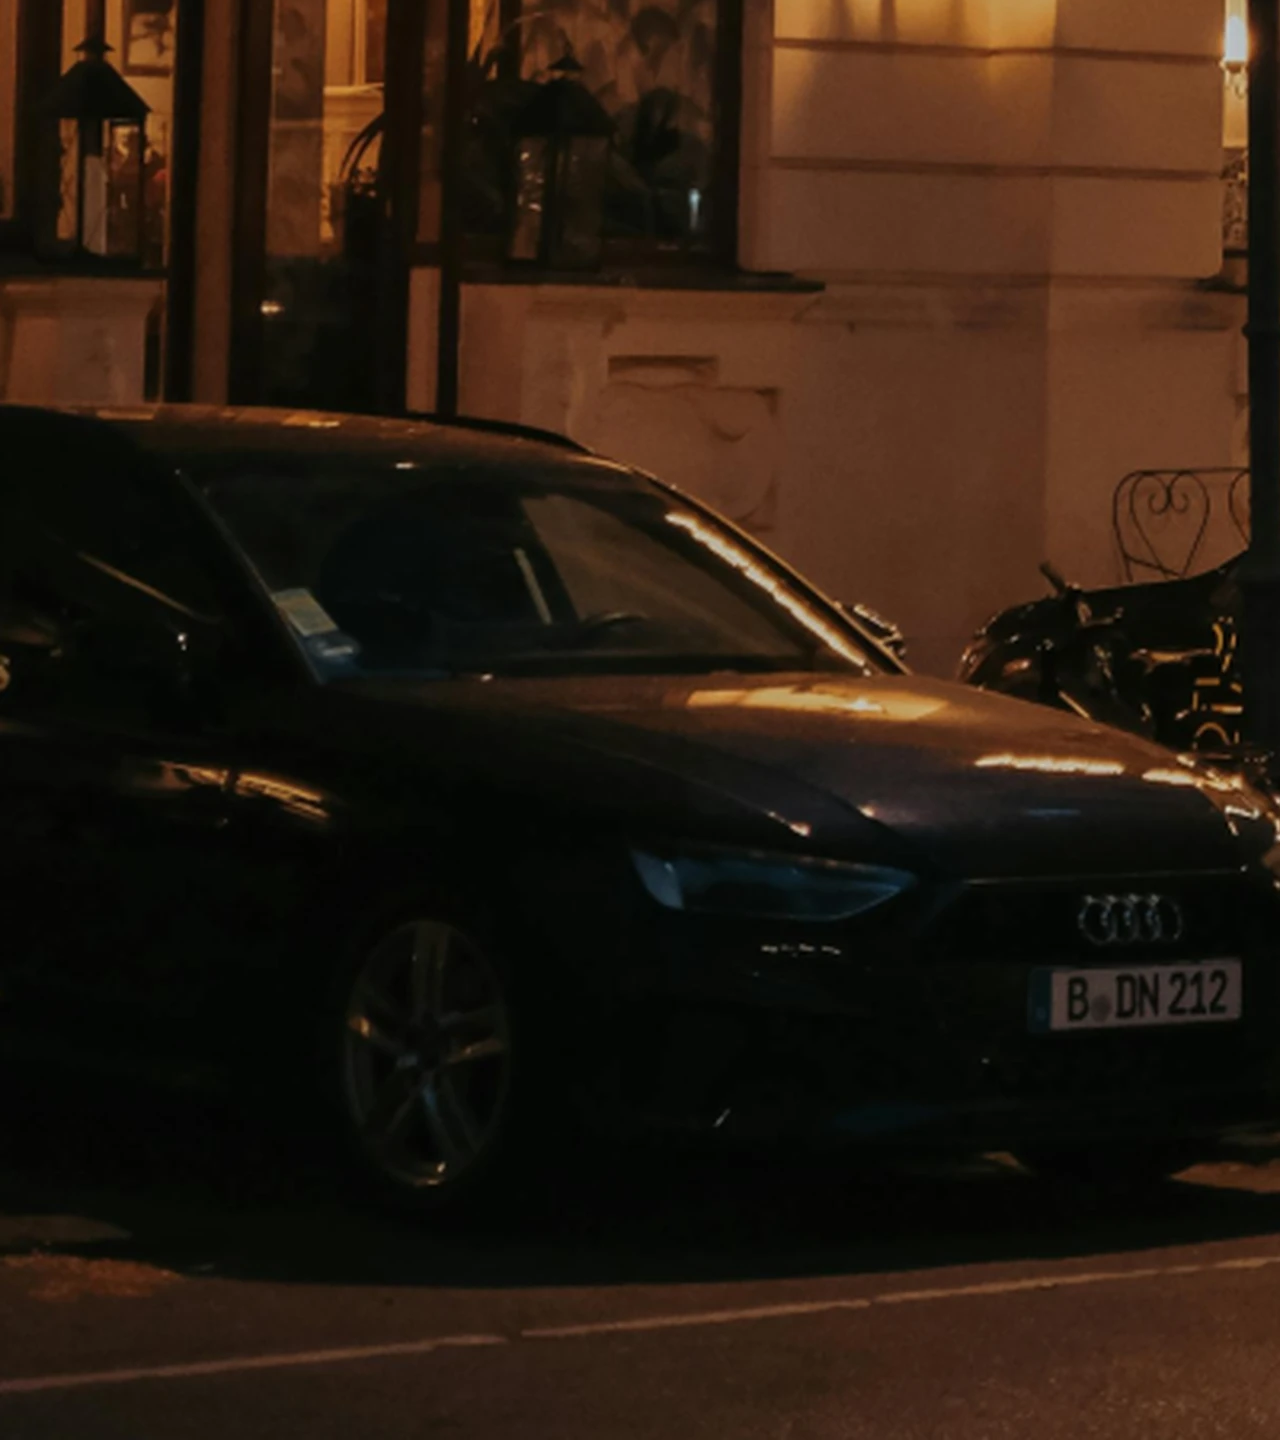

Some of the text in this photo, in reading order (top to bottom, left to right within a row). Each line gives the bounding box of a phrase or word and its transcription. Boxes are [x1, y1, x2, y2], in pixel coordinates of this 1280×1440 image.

[1067, 969, 1228, 1022] B DN 212
